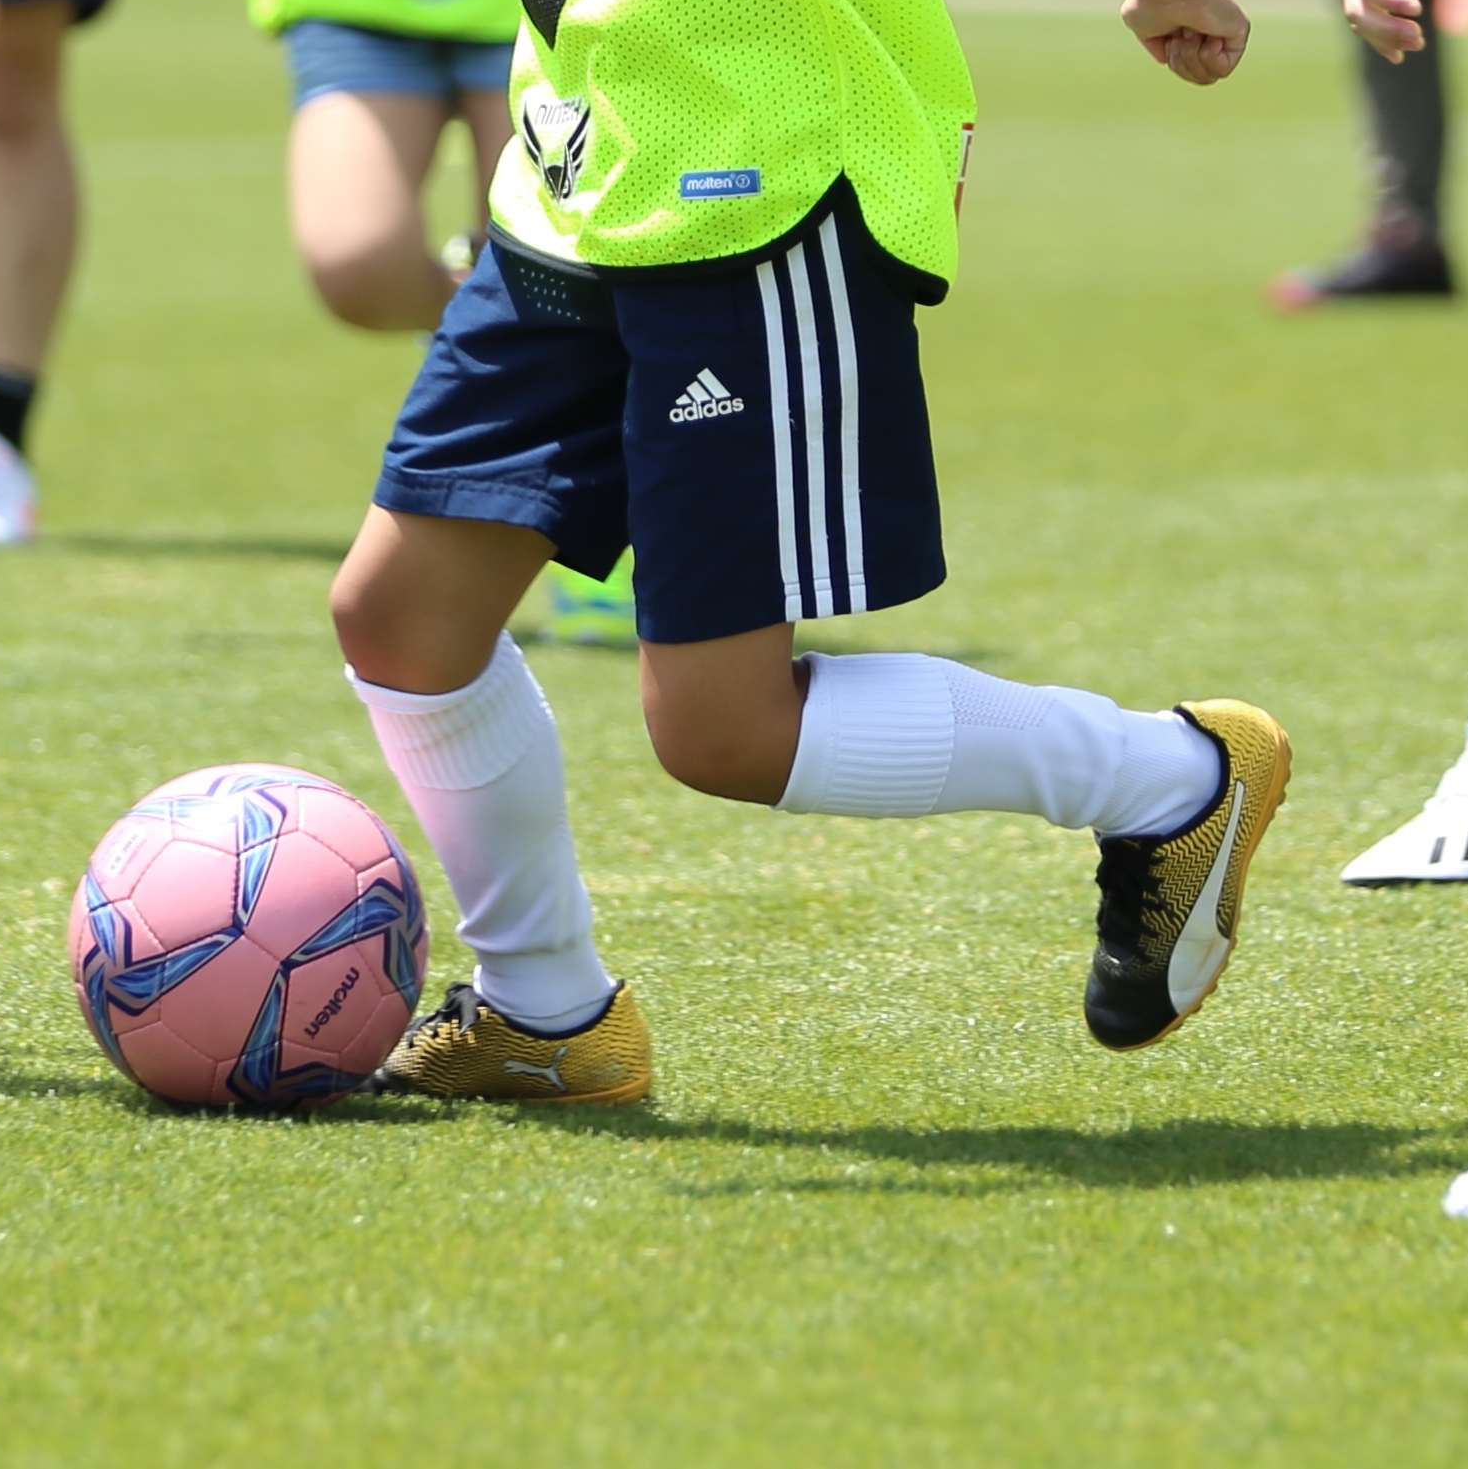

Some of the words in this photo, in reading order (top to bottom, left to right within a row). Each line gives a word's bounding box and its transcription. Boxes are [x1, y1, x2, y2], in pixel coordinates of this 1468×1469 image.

[686, 176, 734, 191] molten
[668, 397, 745, 423] adidas
[303, 966, 360, 1040] molten
